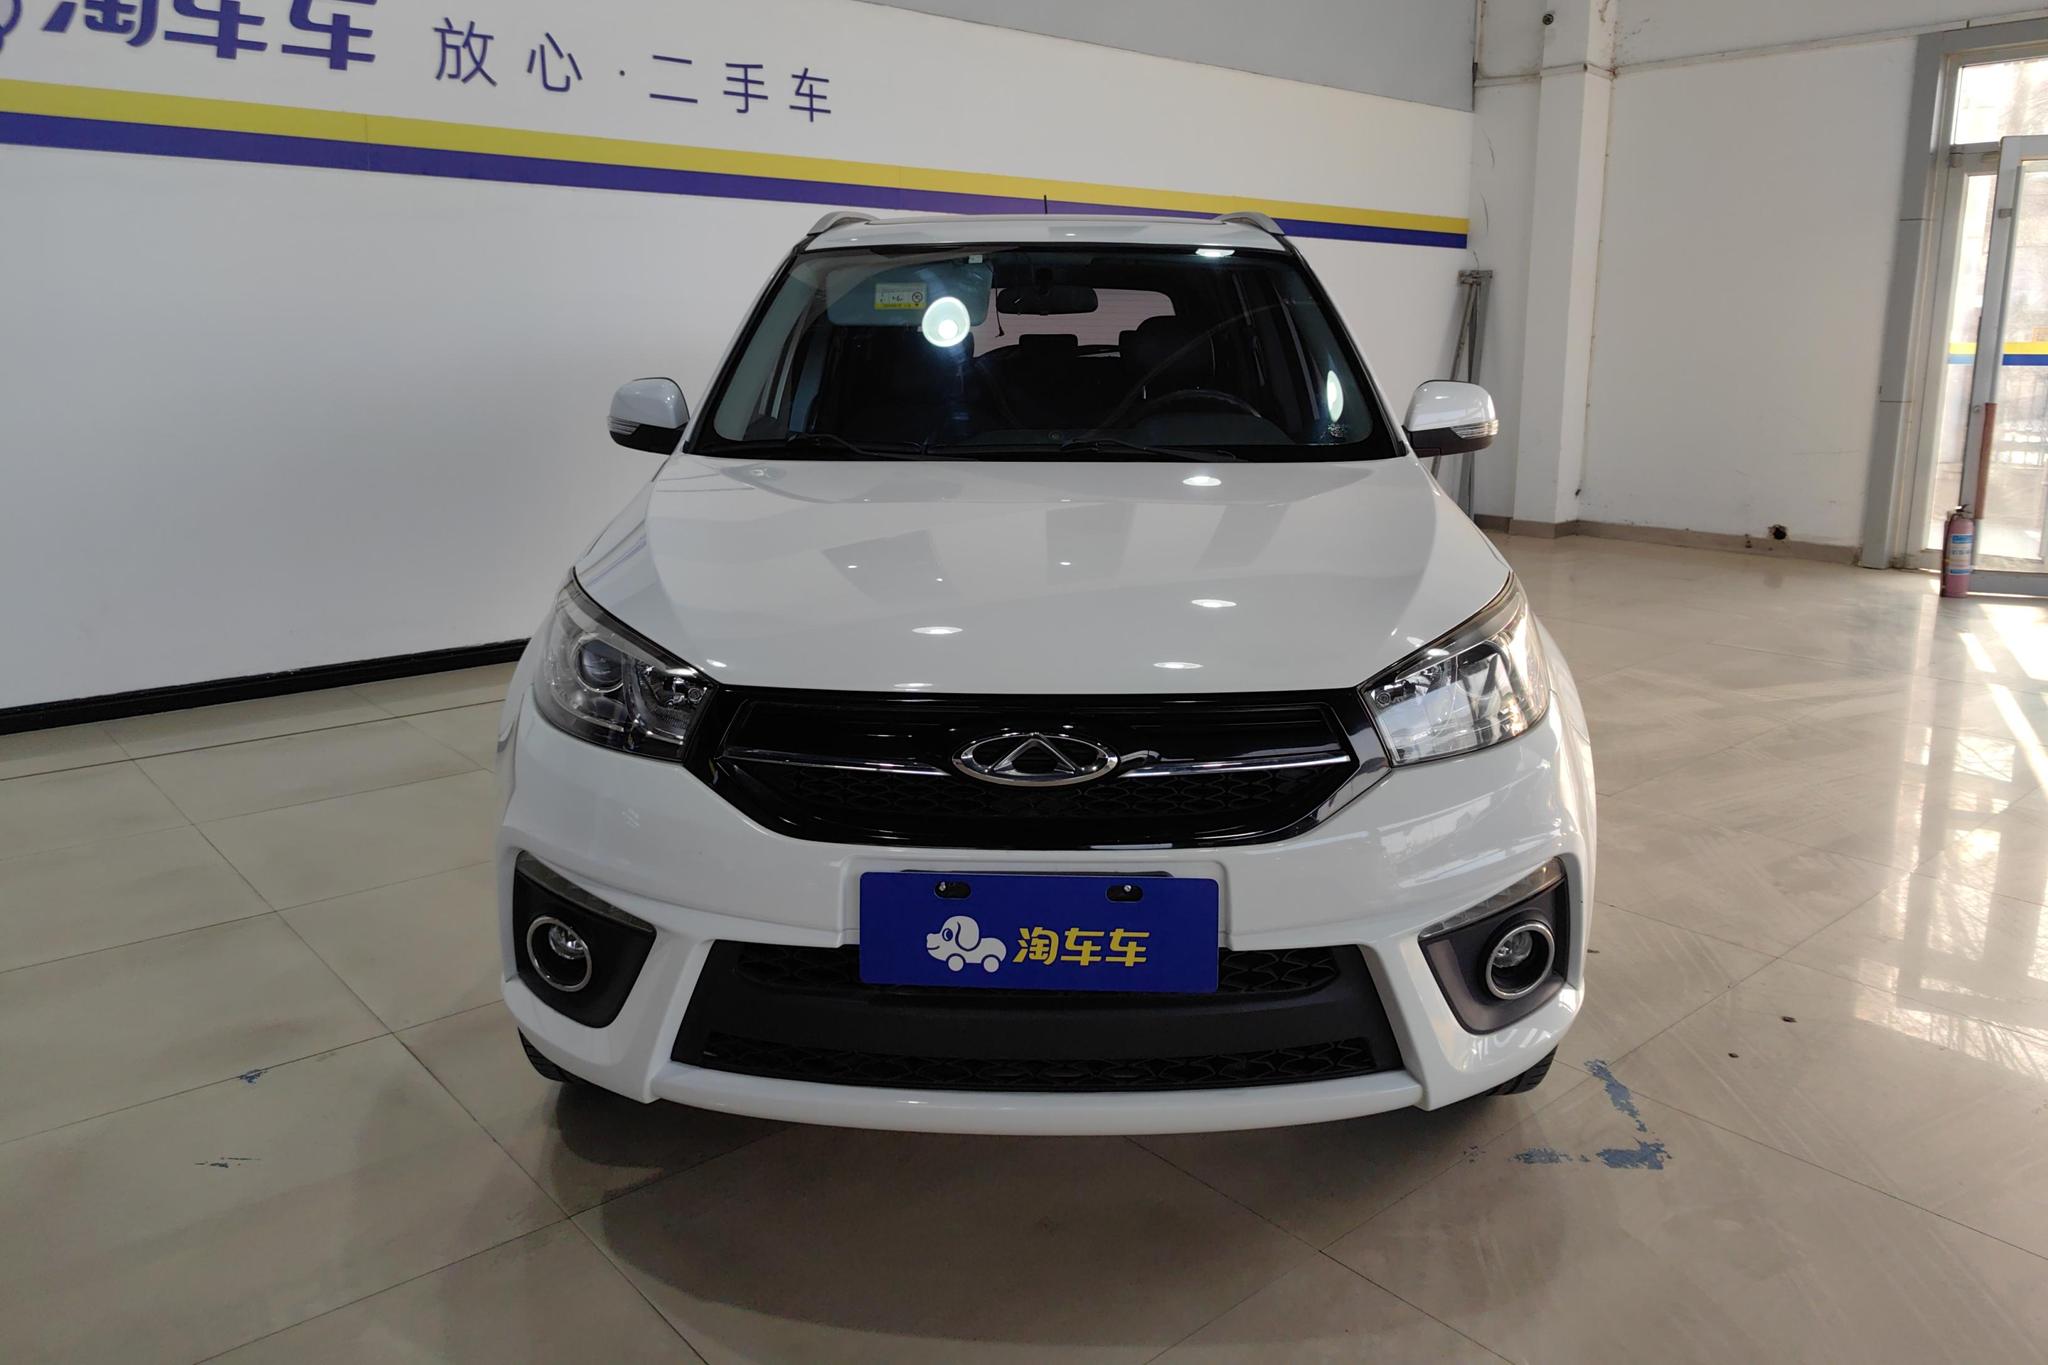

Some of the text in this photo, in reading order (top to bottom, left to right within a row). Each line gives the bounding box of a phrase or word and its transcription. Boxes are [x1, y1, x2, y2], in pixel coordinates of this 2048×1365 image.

[433, 17, 831, 122] 放心·二手车
[1012, 927, 1150, 967] 淘车车
